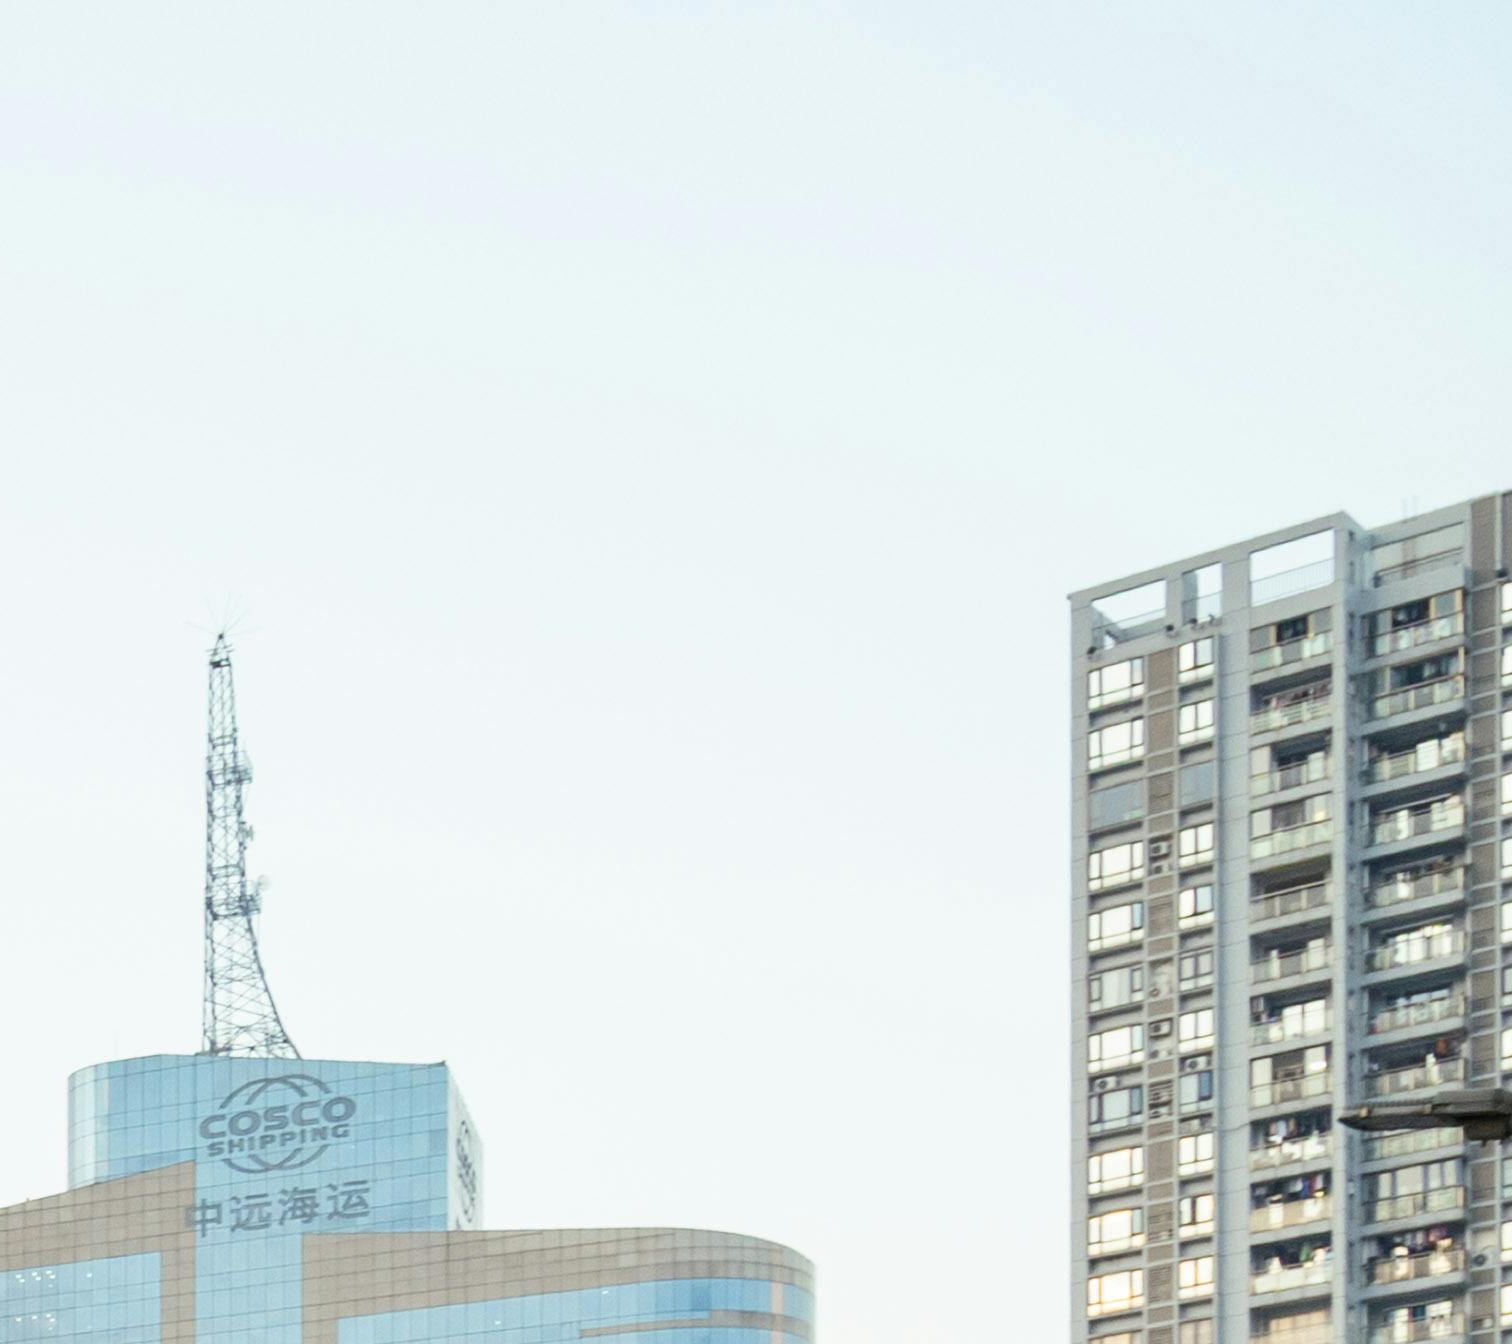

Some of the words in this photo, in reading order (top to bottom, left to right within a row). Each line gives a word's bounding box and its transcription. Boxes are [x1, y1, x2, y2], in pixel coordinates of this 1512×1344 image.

[199, 1096, 357, 1139] COSCO
[207, 1123, 350, 1158] SHIPPING
[184, 1180, 370, 1238] 中远海运
